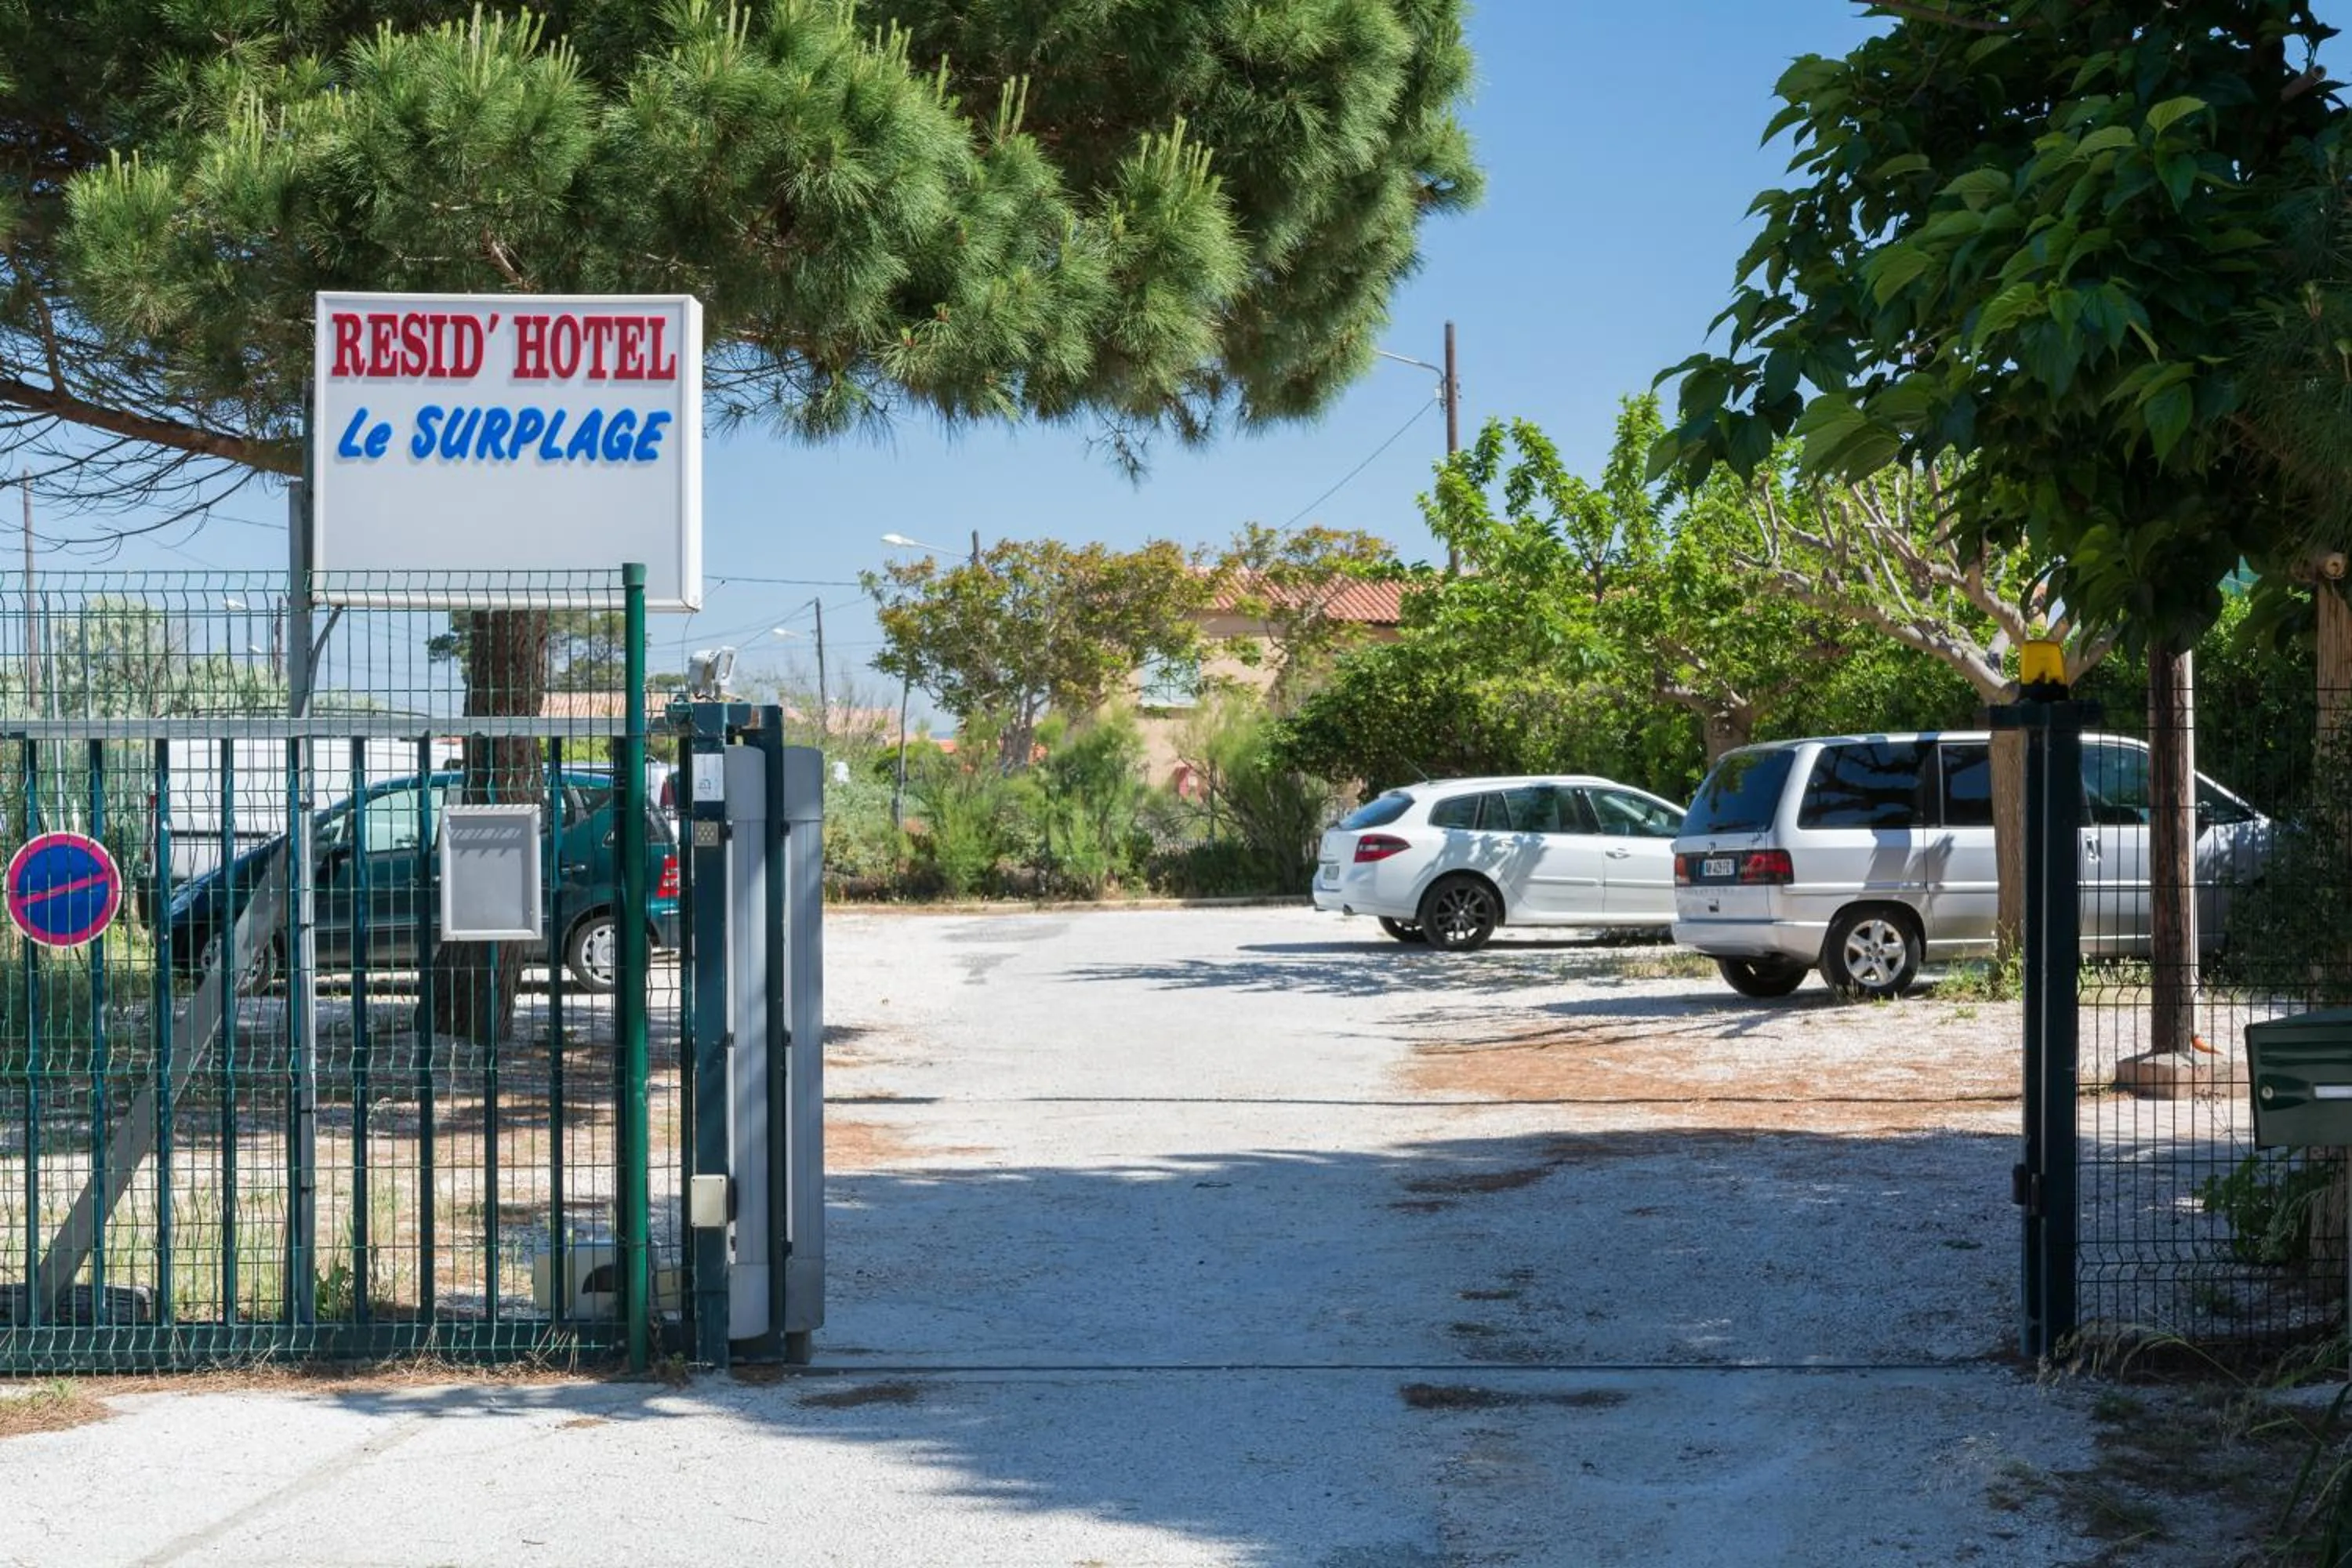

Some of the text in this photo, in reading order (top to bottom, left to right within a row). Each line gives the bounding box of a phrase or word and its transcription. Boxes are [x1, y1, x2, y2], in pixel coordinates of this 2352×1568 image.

[332, 312, 676, 379] RESID' HOTEL
[338, 405, 673, 462] Le SURPLAGE
